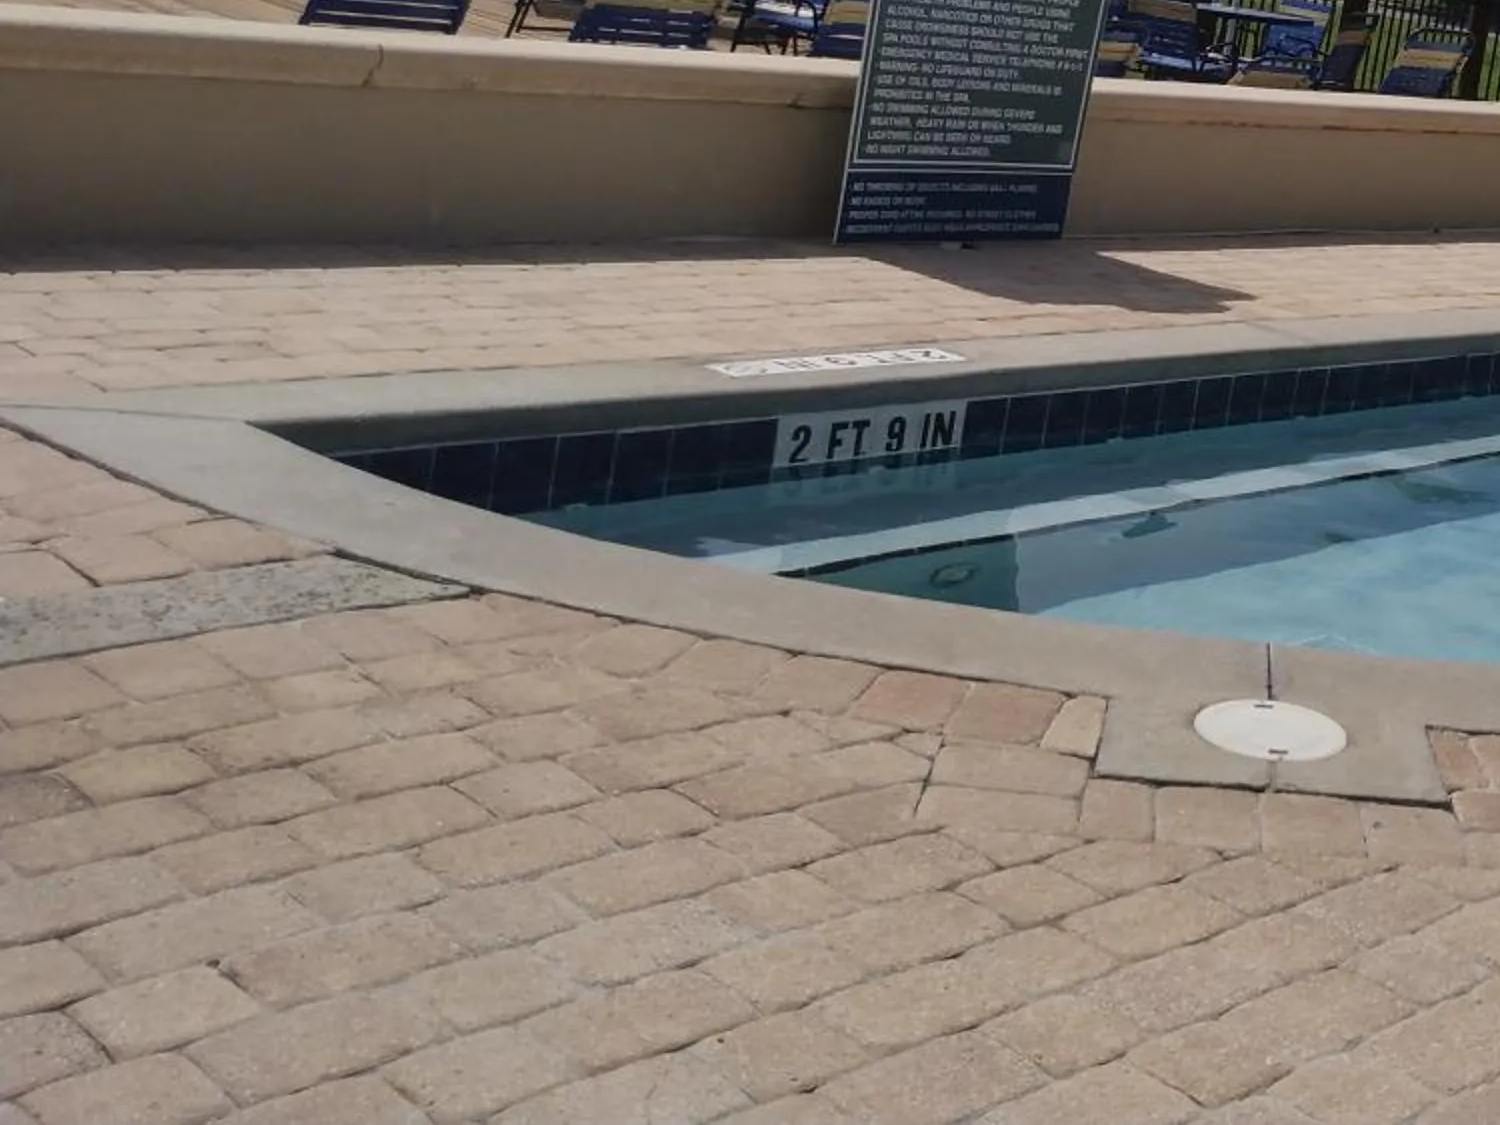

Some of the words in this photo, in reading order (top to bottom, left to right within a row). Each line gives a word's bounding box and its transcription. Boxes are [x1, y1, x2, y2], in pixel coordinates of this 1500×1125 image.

[788, 425, 812, 464] 2
[826, 420, 870, 459] FT
[885, 416, 907, 452] 9
[919, 410, 957, 449] IN
